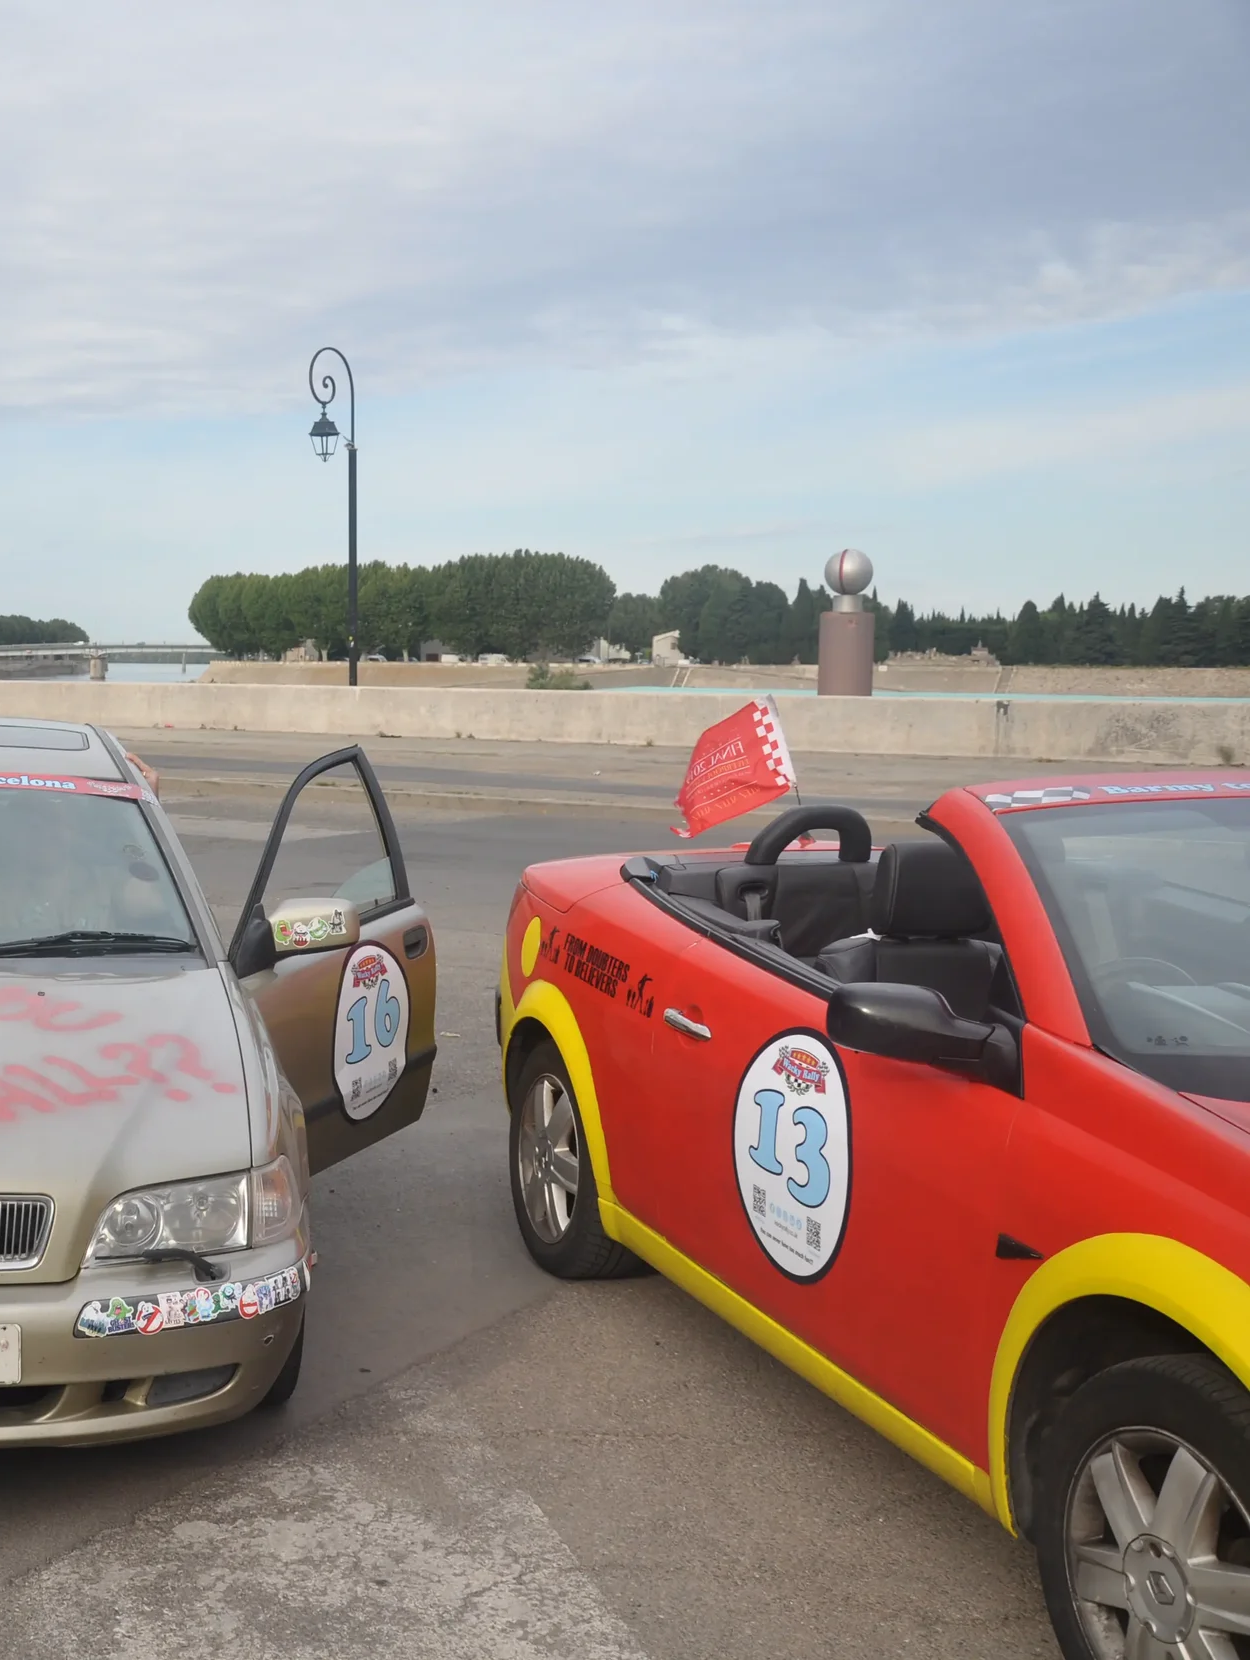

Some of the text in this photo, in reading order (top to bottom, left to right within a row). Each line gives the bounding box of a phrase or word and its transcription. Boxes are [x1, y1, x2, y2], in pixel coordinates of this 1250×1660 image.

[1097, 784, 1215, 794] Barmy
[563, 933, 630, 983] FROM DOUBTERS
[564, 952, 619, 998] TO BELIEVERS
[345, 979, 401, 1064] 16
[783, 1057, 821, 1083] Wacky Rally
[748, 1088, 831, 1209] 13
